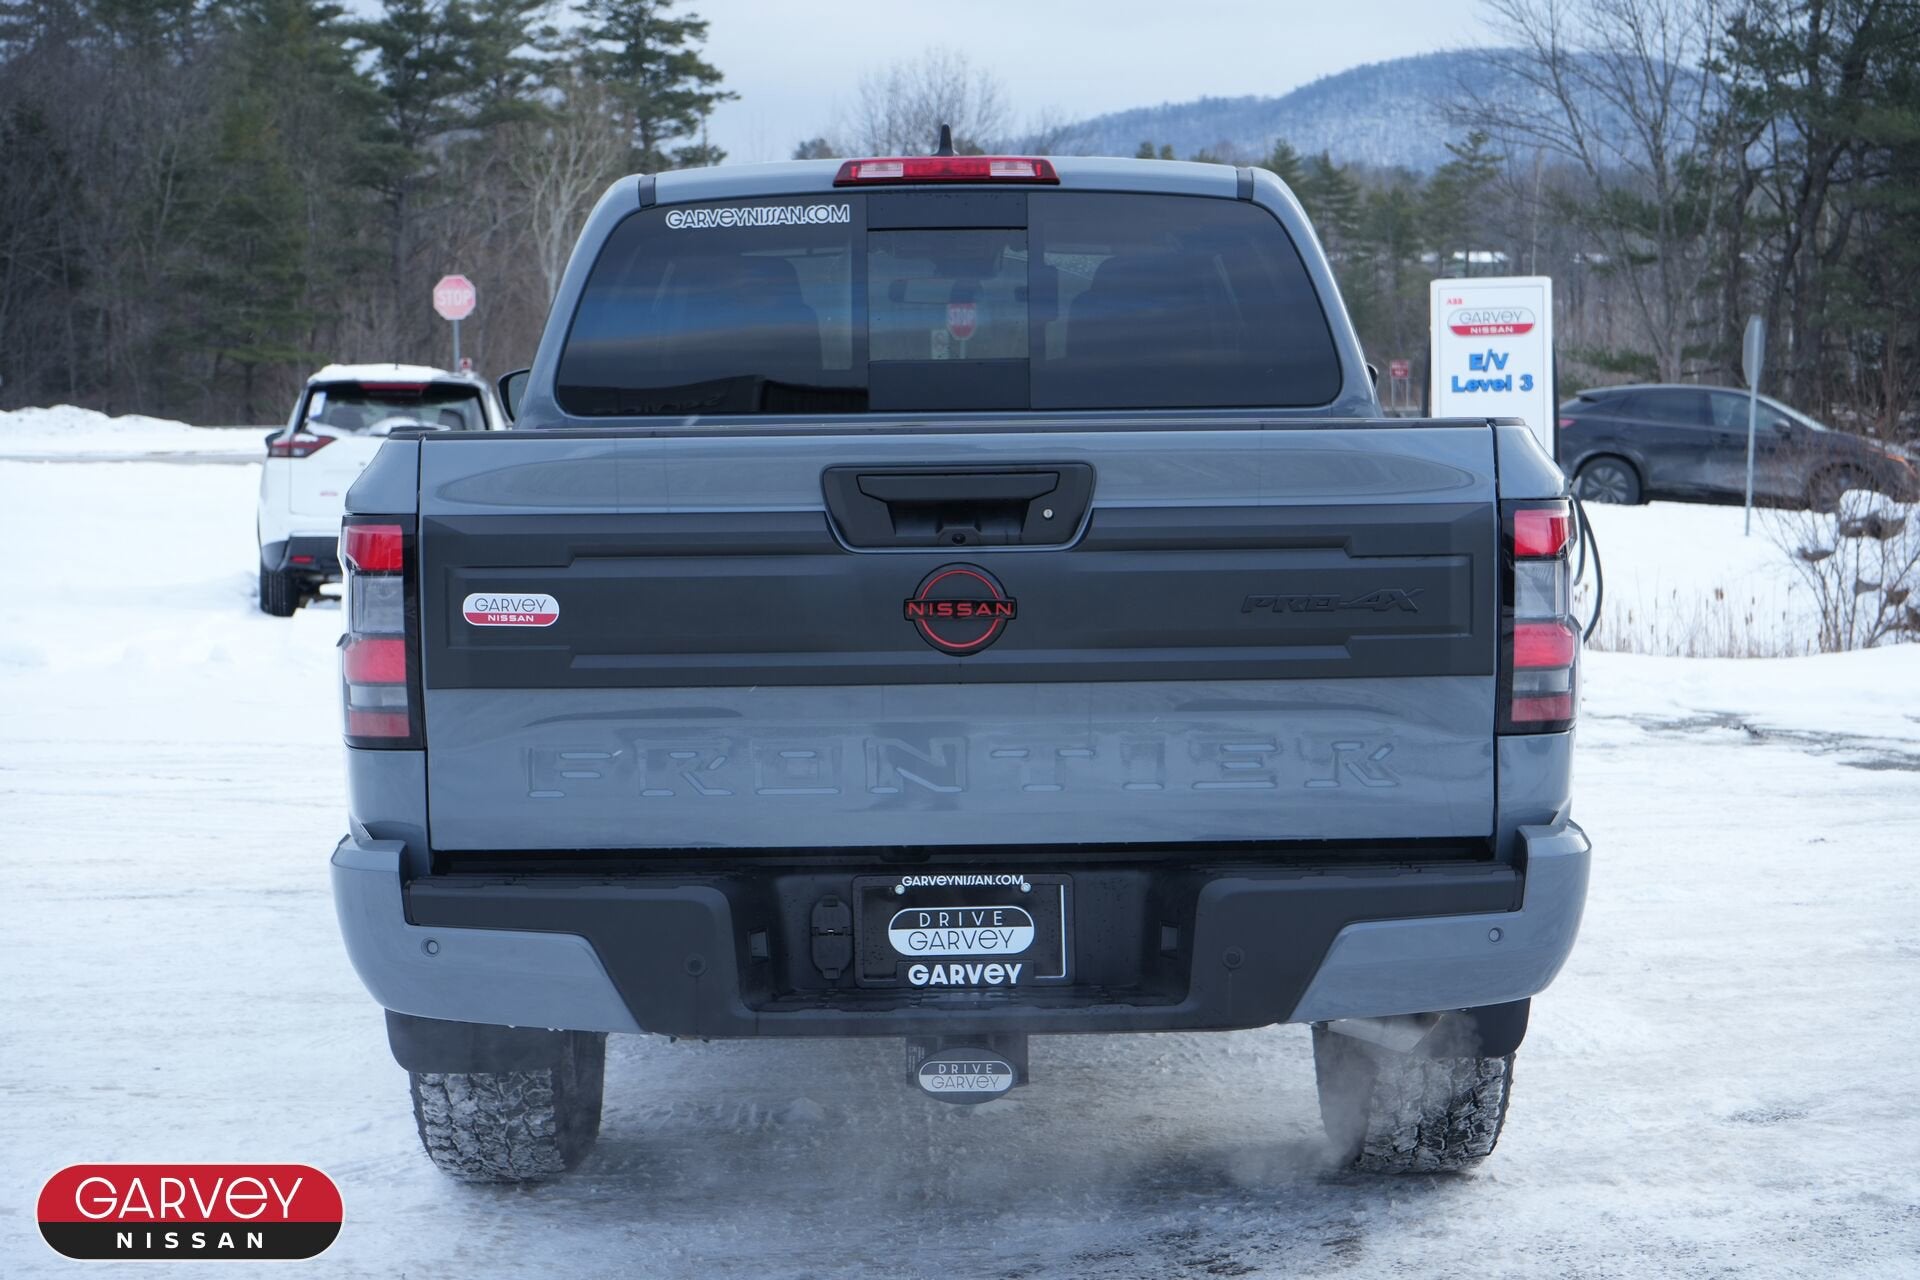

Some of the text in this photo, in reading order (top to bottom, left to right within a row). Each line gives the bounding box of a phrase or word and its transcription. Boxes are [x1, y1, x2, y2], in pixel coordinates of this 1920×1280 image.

[438, 289, 472, 306] STOP
[1470, 326, 1514, 335] NISSAN
[1469, 348, 1509, 373] E/V
[1451, 373, 1534, 393] Level 3
[908, 602, 1012, 616] NISSAN
[1241, 588, 1424, 613] PRO-4X
[487, 614, 534, 622] NISSAN
[525, 737, 1400, 798] FRONTIER
[919, 911, 1003, 928] DRIVE
[938, 1063, 993, 1074] DRIVE
